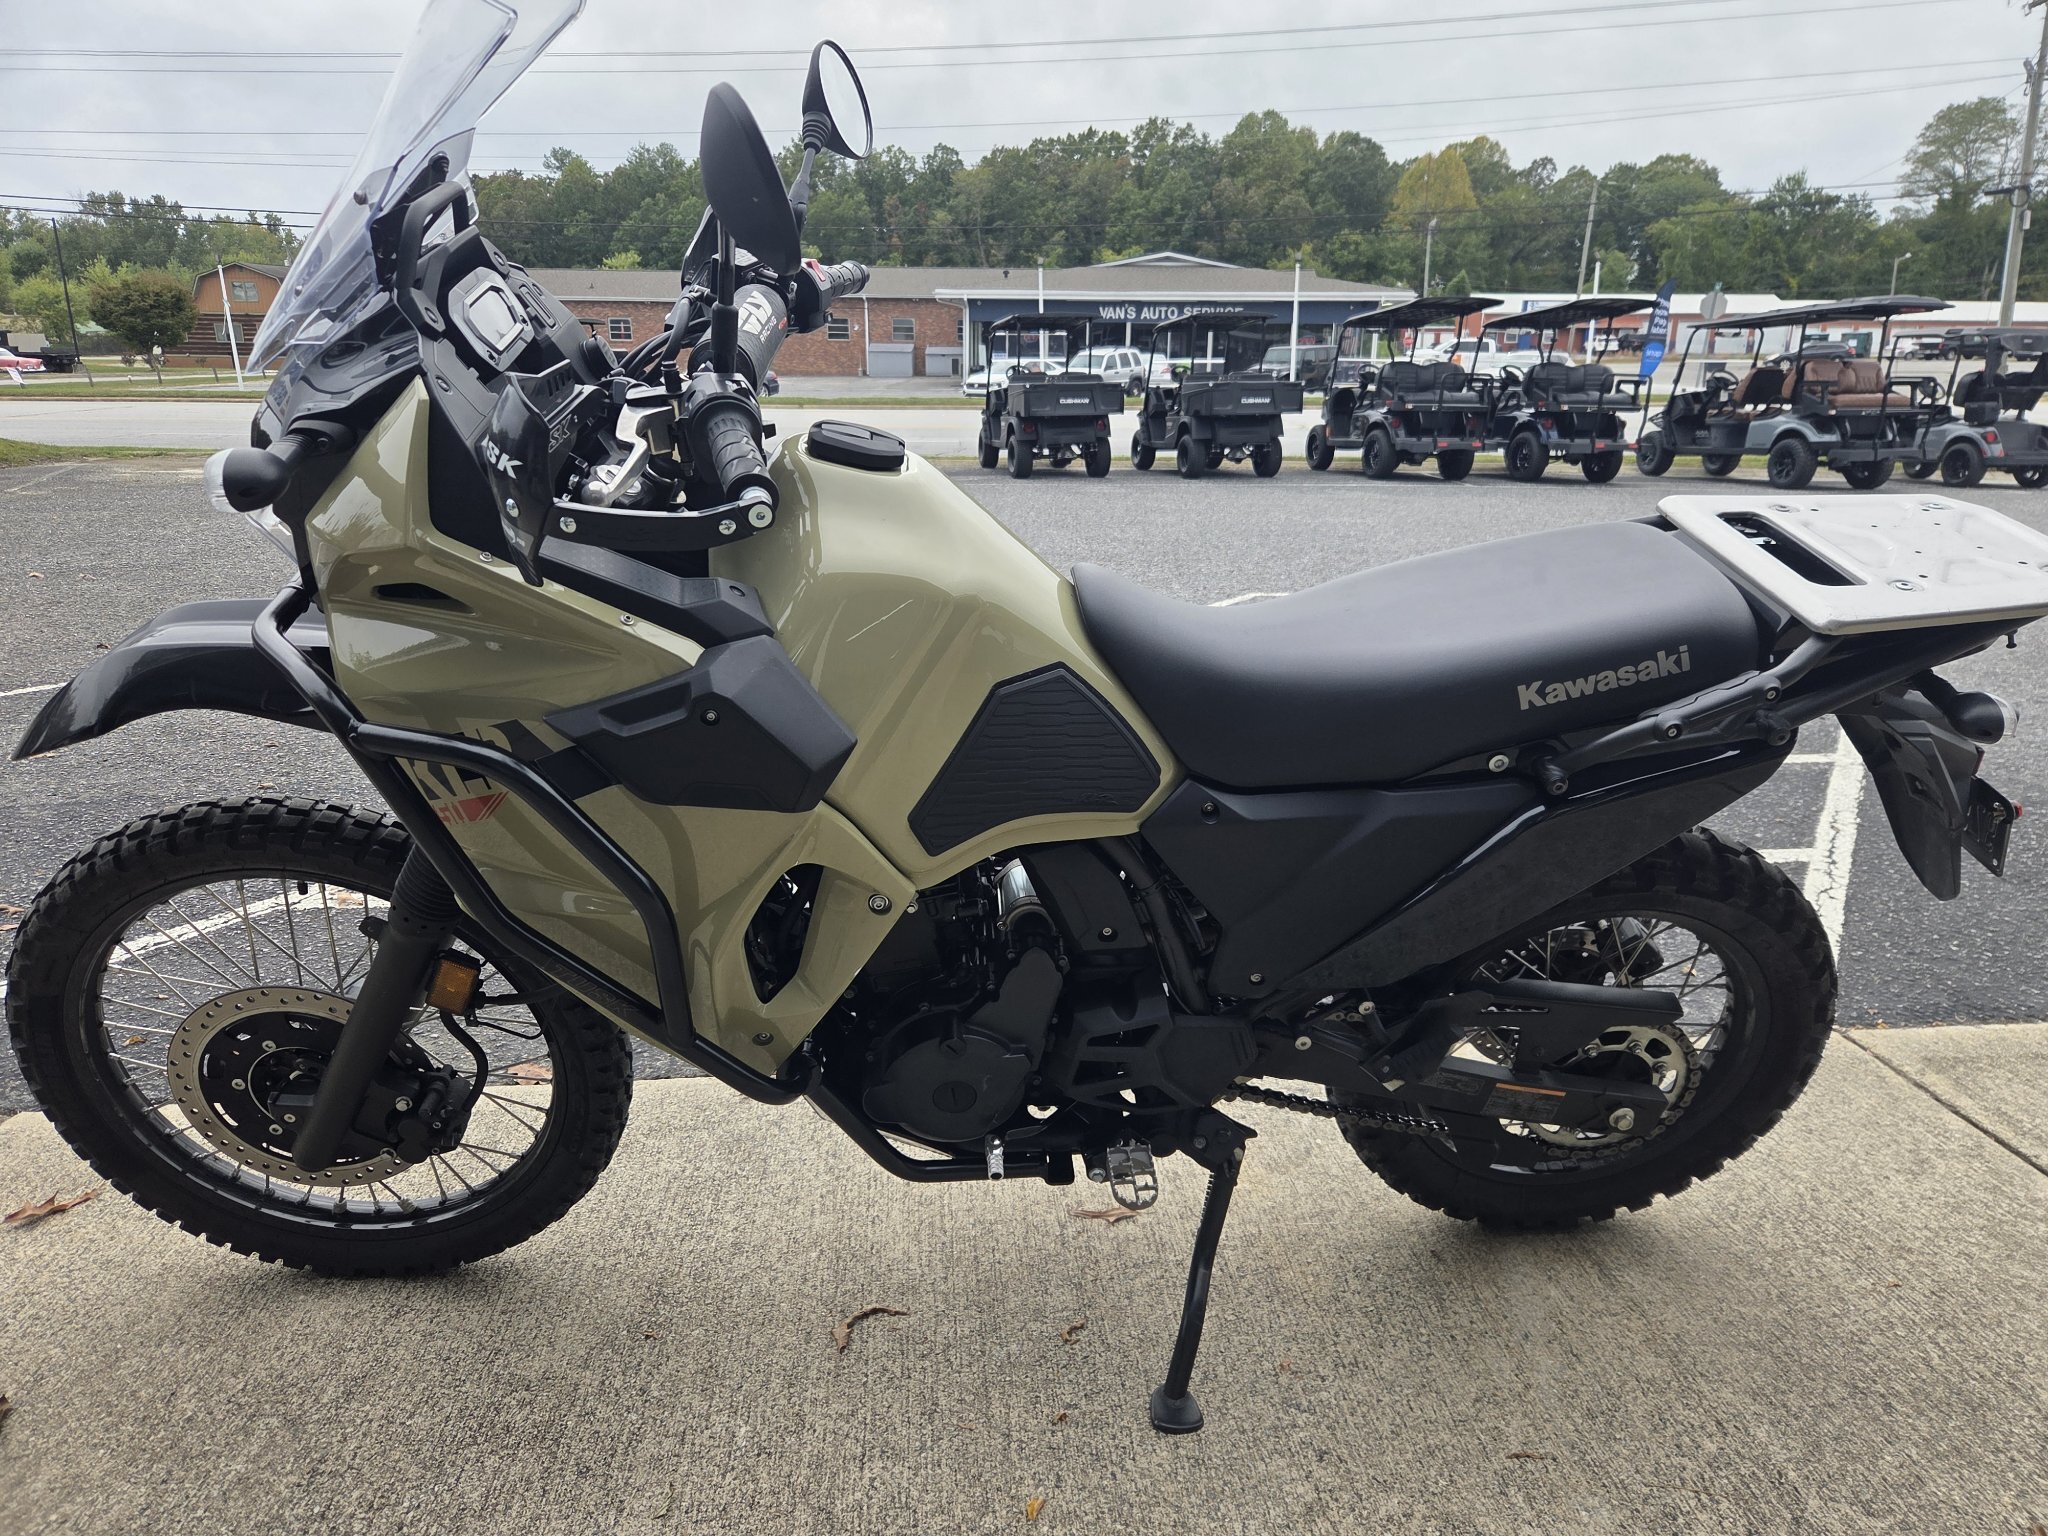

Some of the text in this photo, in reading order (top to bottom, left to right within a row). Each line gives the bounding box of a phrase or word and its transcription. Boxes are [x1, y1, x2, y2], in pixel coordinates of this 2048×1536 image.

[1099, 303, 1136, 320] VAN'S
[1140, 306, 1178, 320] AUTO
[760, 315, 777, 344] RACING
[1517, 644, 1691, 711] Kawasaki
